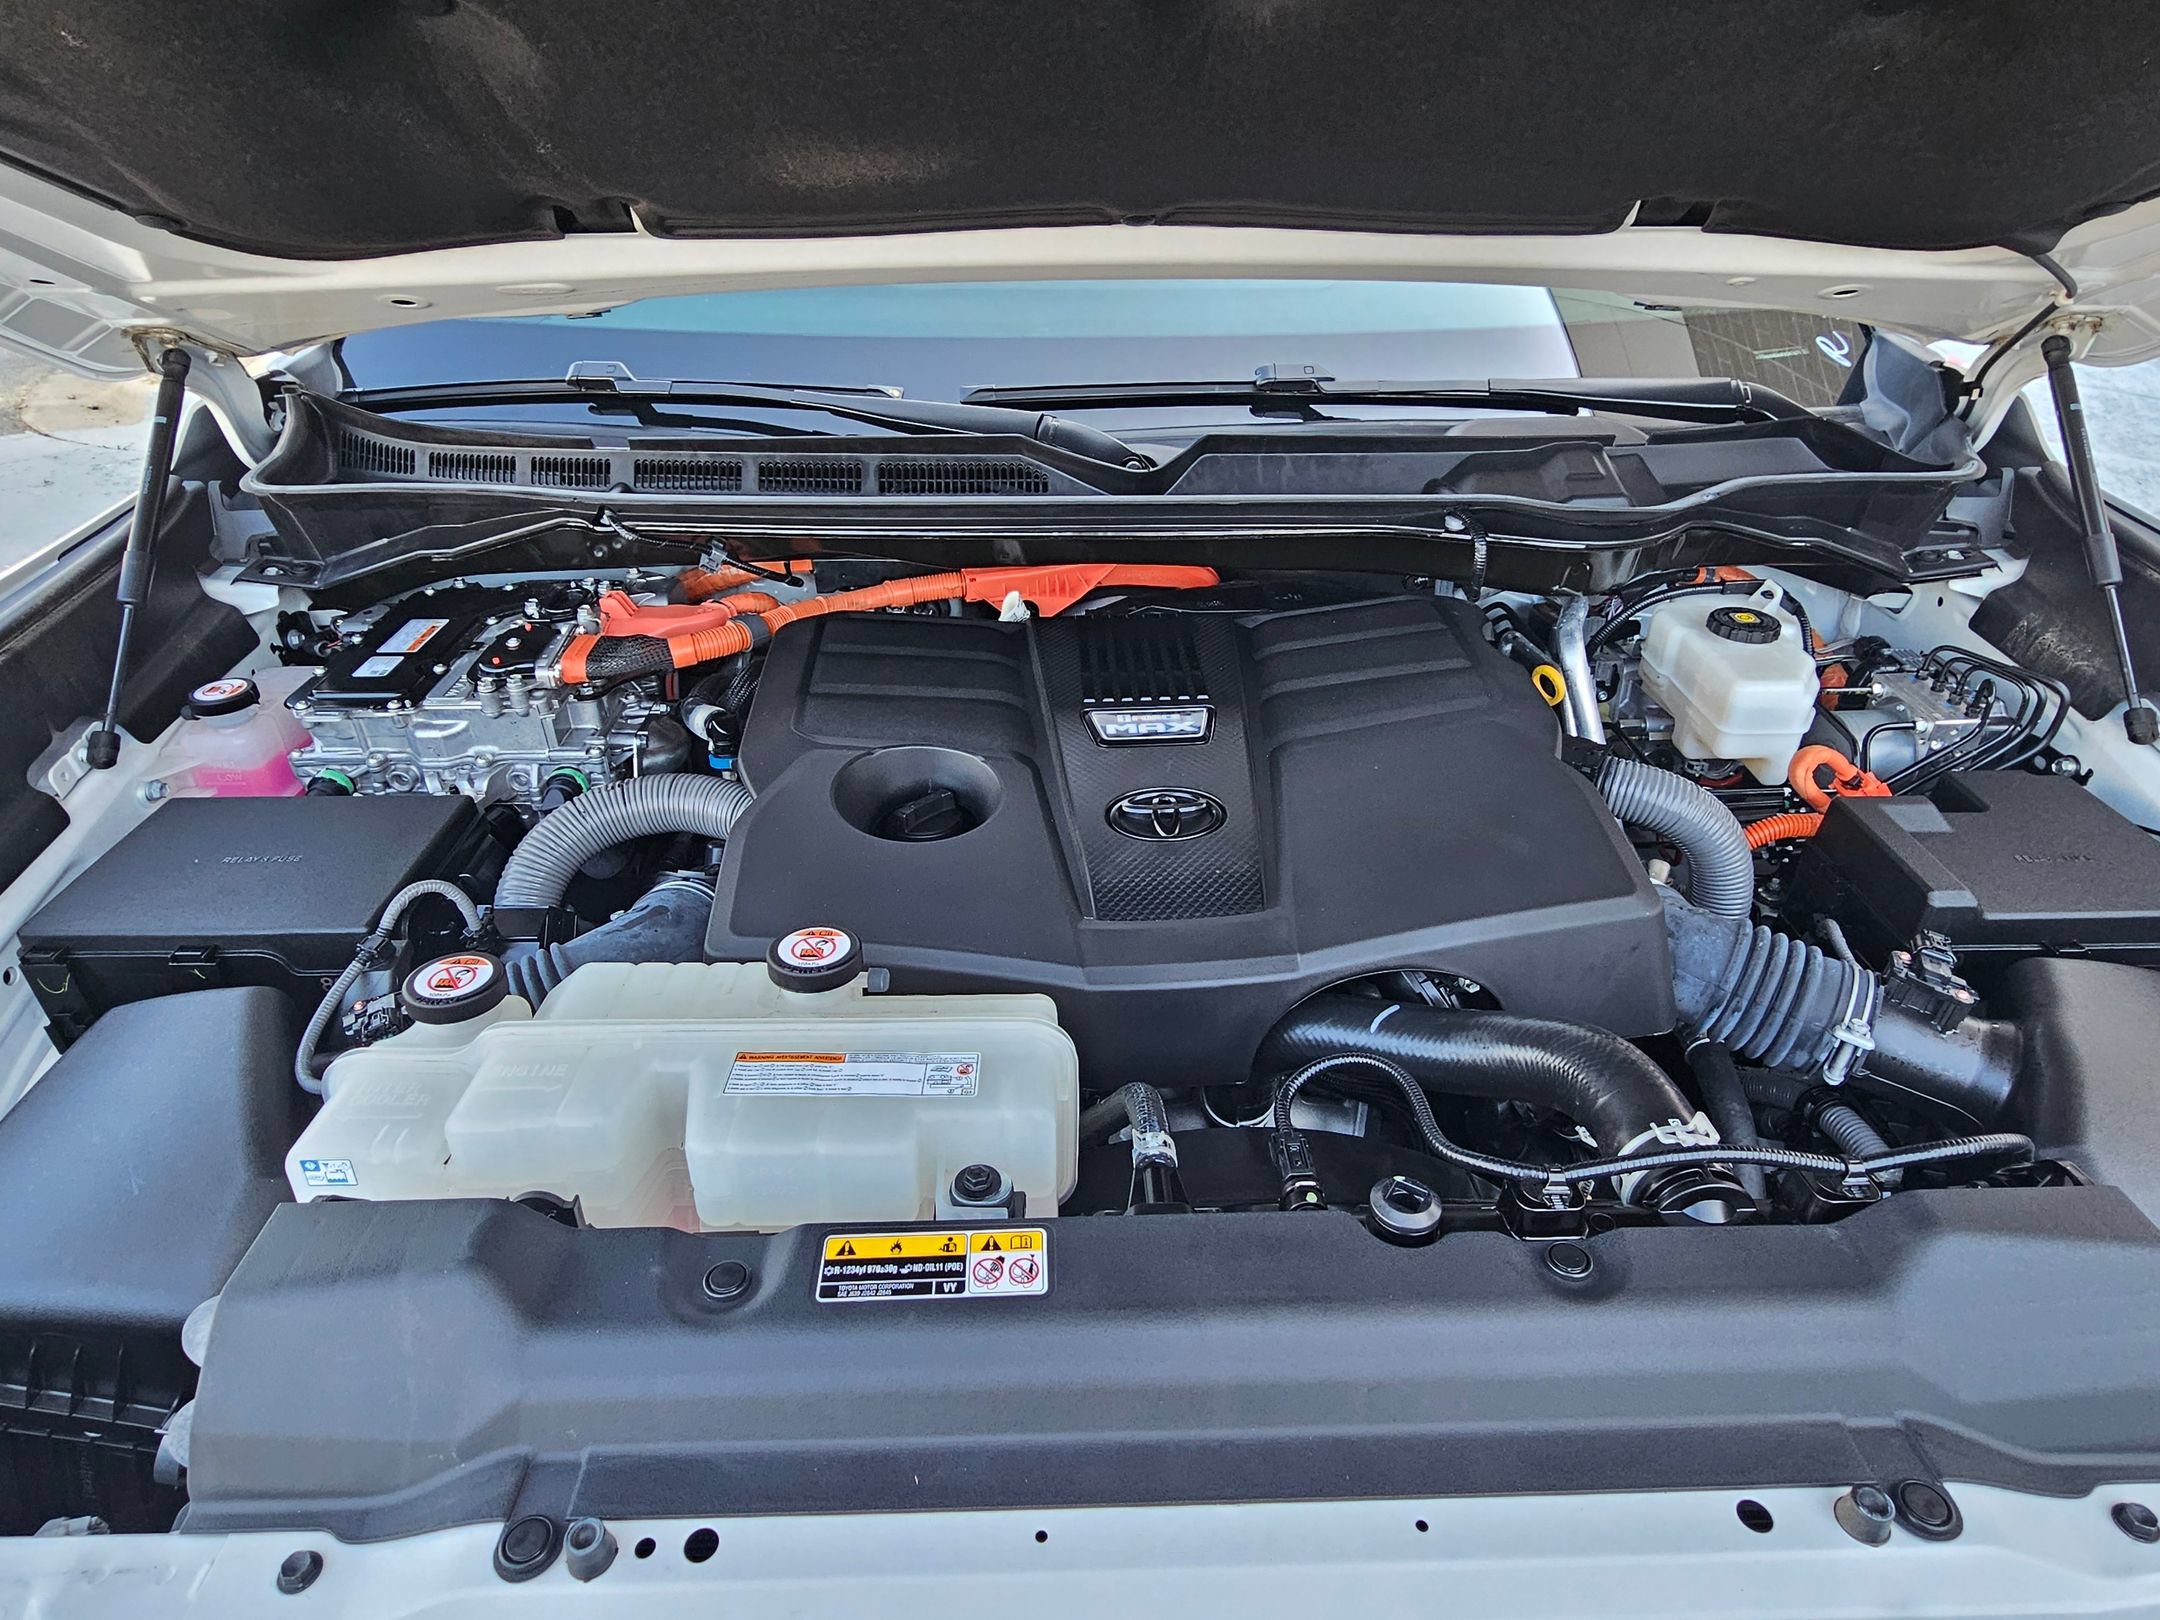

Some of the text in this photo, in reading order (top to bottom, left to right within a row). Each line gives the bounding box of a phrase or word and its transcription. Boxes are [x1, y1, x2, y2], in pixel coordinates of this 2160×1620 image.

[1105, 721, 1200, 735] MAX
[222, 855, 260, 864] RELAY
[271, 855, 304, 863] FUSE
[491, 1063, 568, 1077] ENGINE
[350, 1093, 431, 1106] COOLER
[913, 1262, 944, 1273] ND-OIL11
[944, 1262, 964, 1273] (POE)
[878, 1283, 914, 1291] CORPORATION
[943, 1282, 958, 1293] VY
